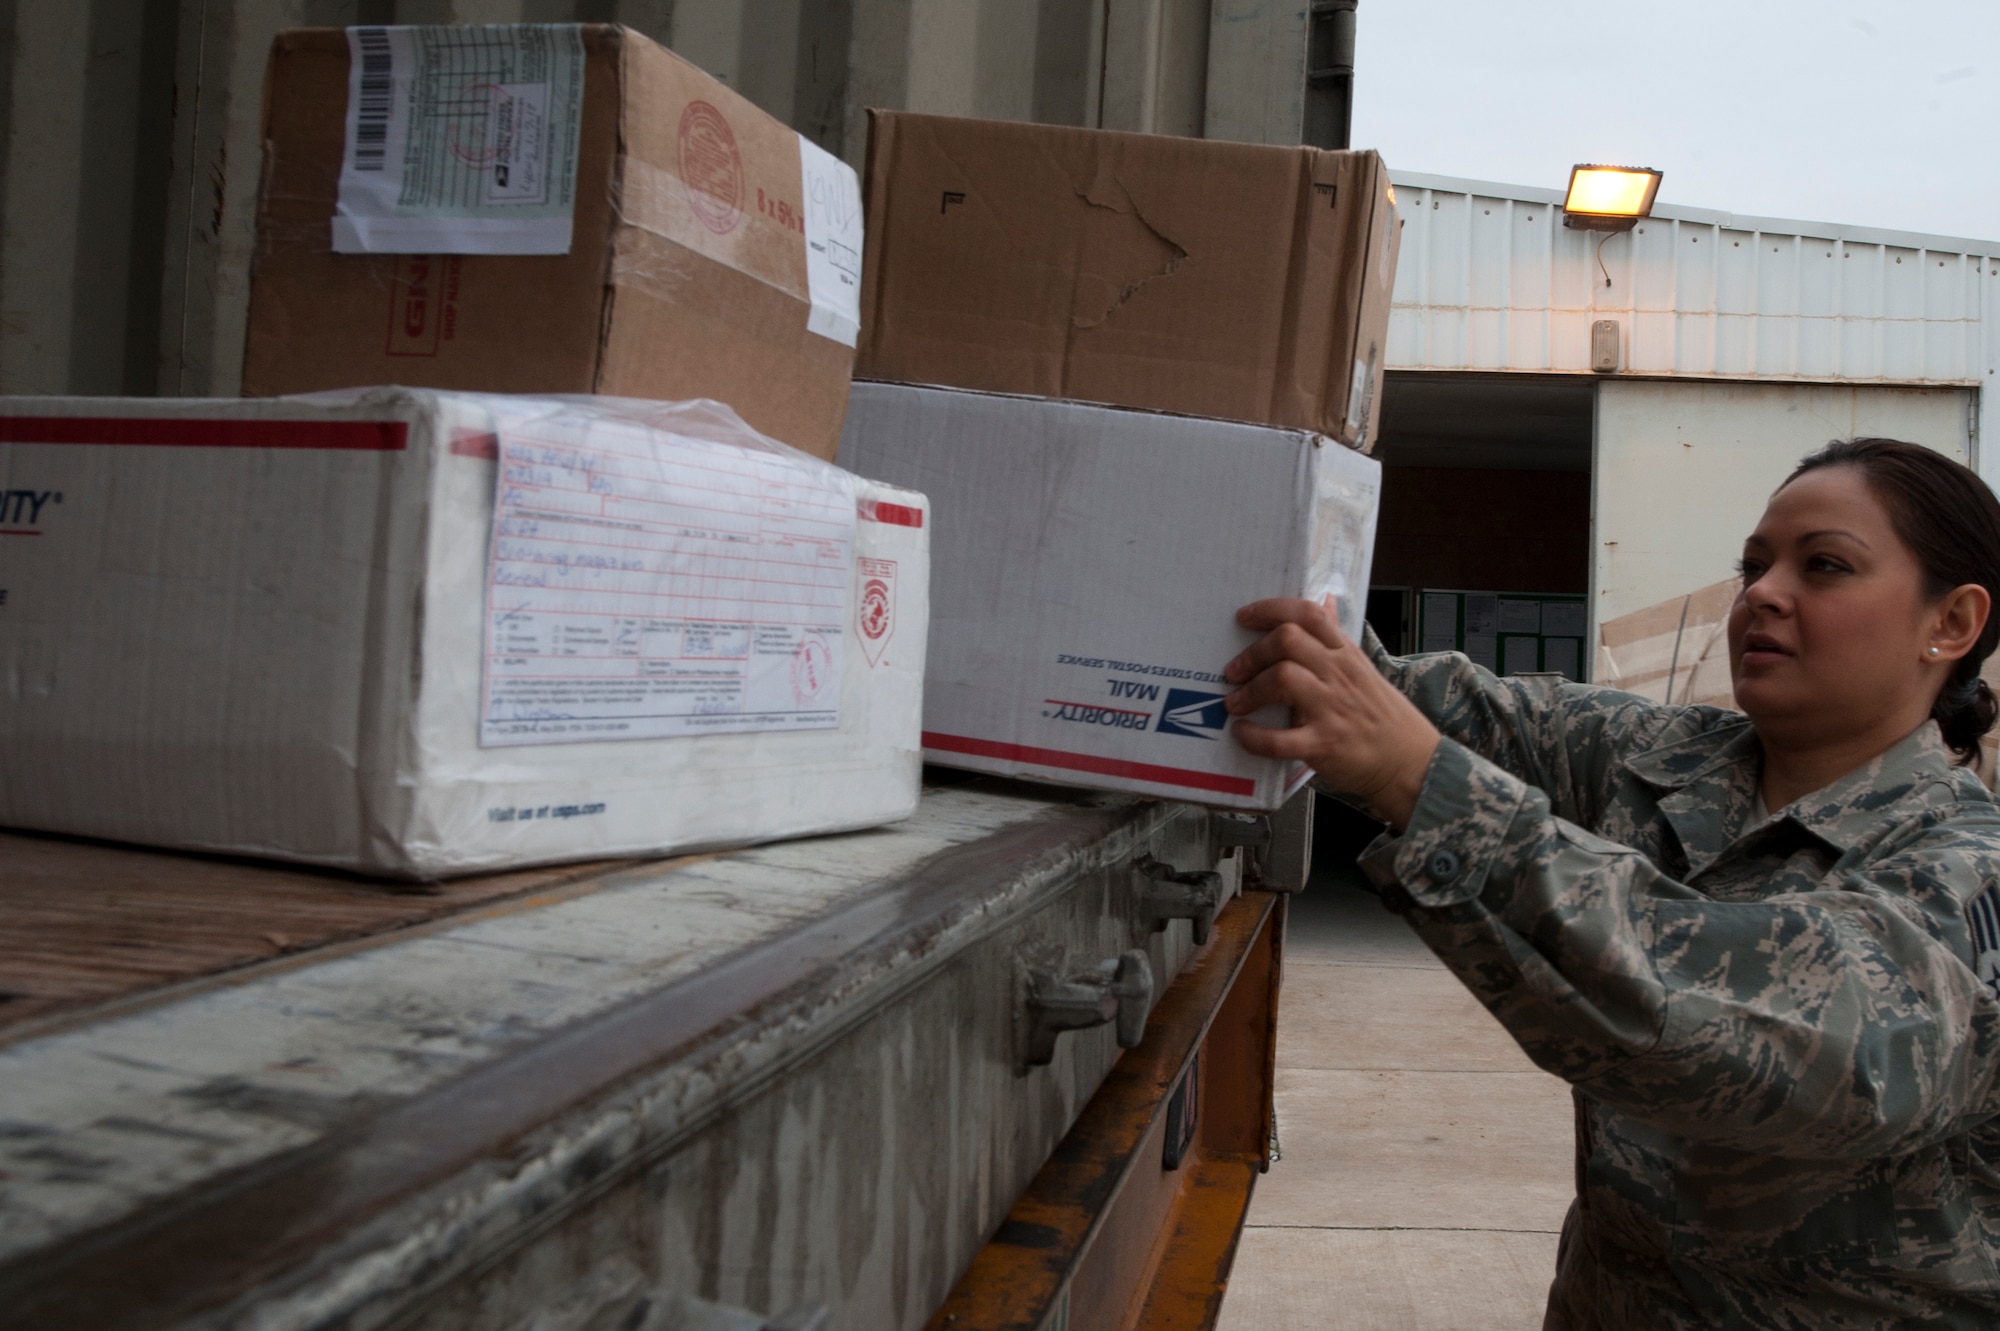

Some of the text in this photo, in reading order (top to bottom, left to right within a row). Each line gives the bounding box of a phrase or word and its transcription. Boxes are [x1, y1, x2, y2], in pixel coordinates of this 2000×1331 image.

[0, 489, 51, 525] ITY
[1056, 654, 1228, 684] NITED STATES POSTAL SERVICE
[1107, 679, 1160, 701] MAIL
[1053, 704, 1150, 731] PRIORITY
